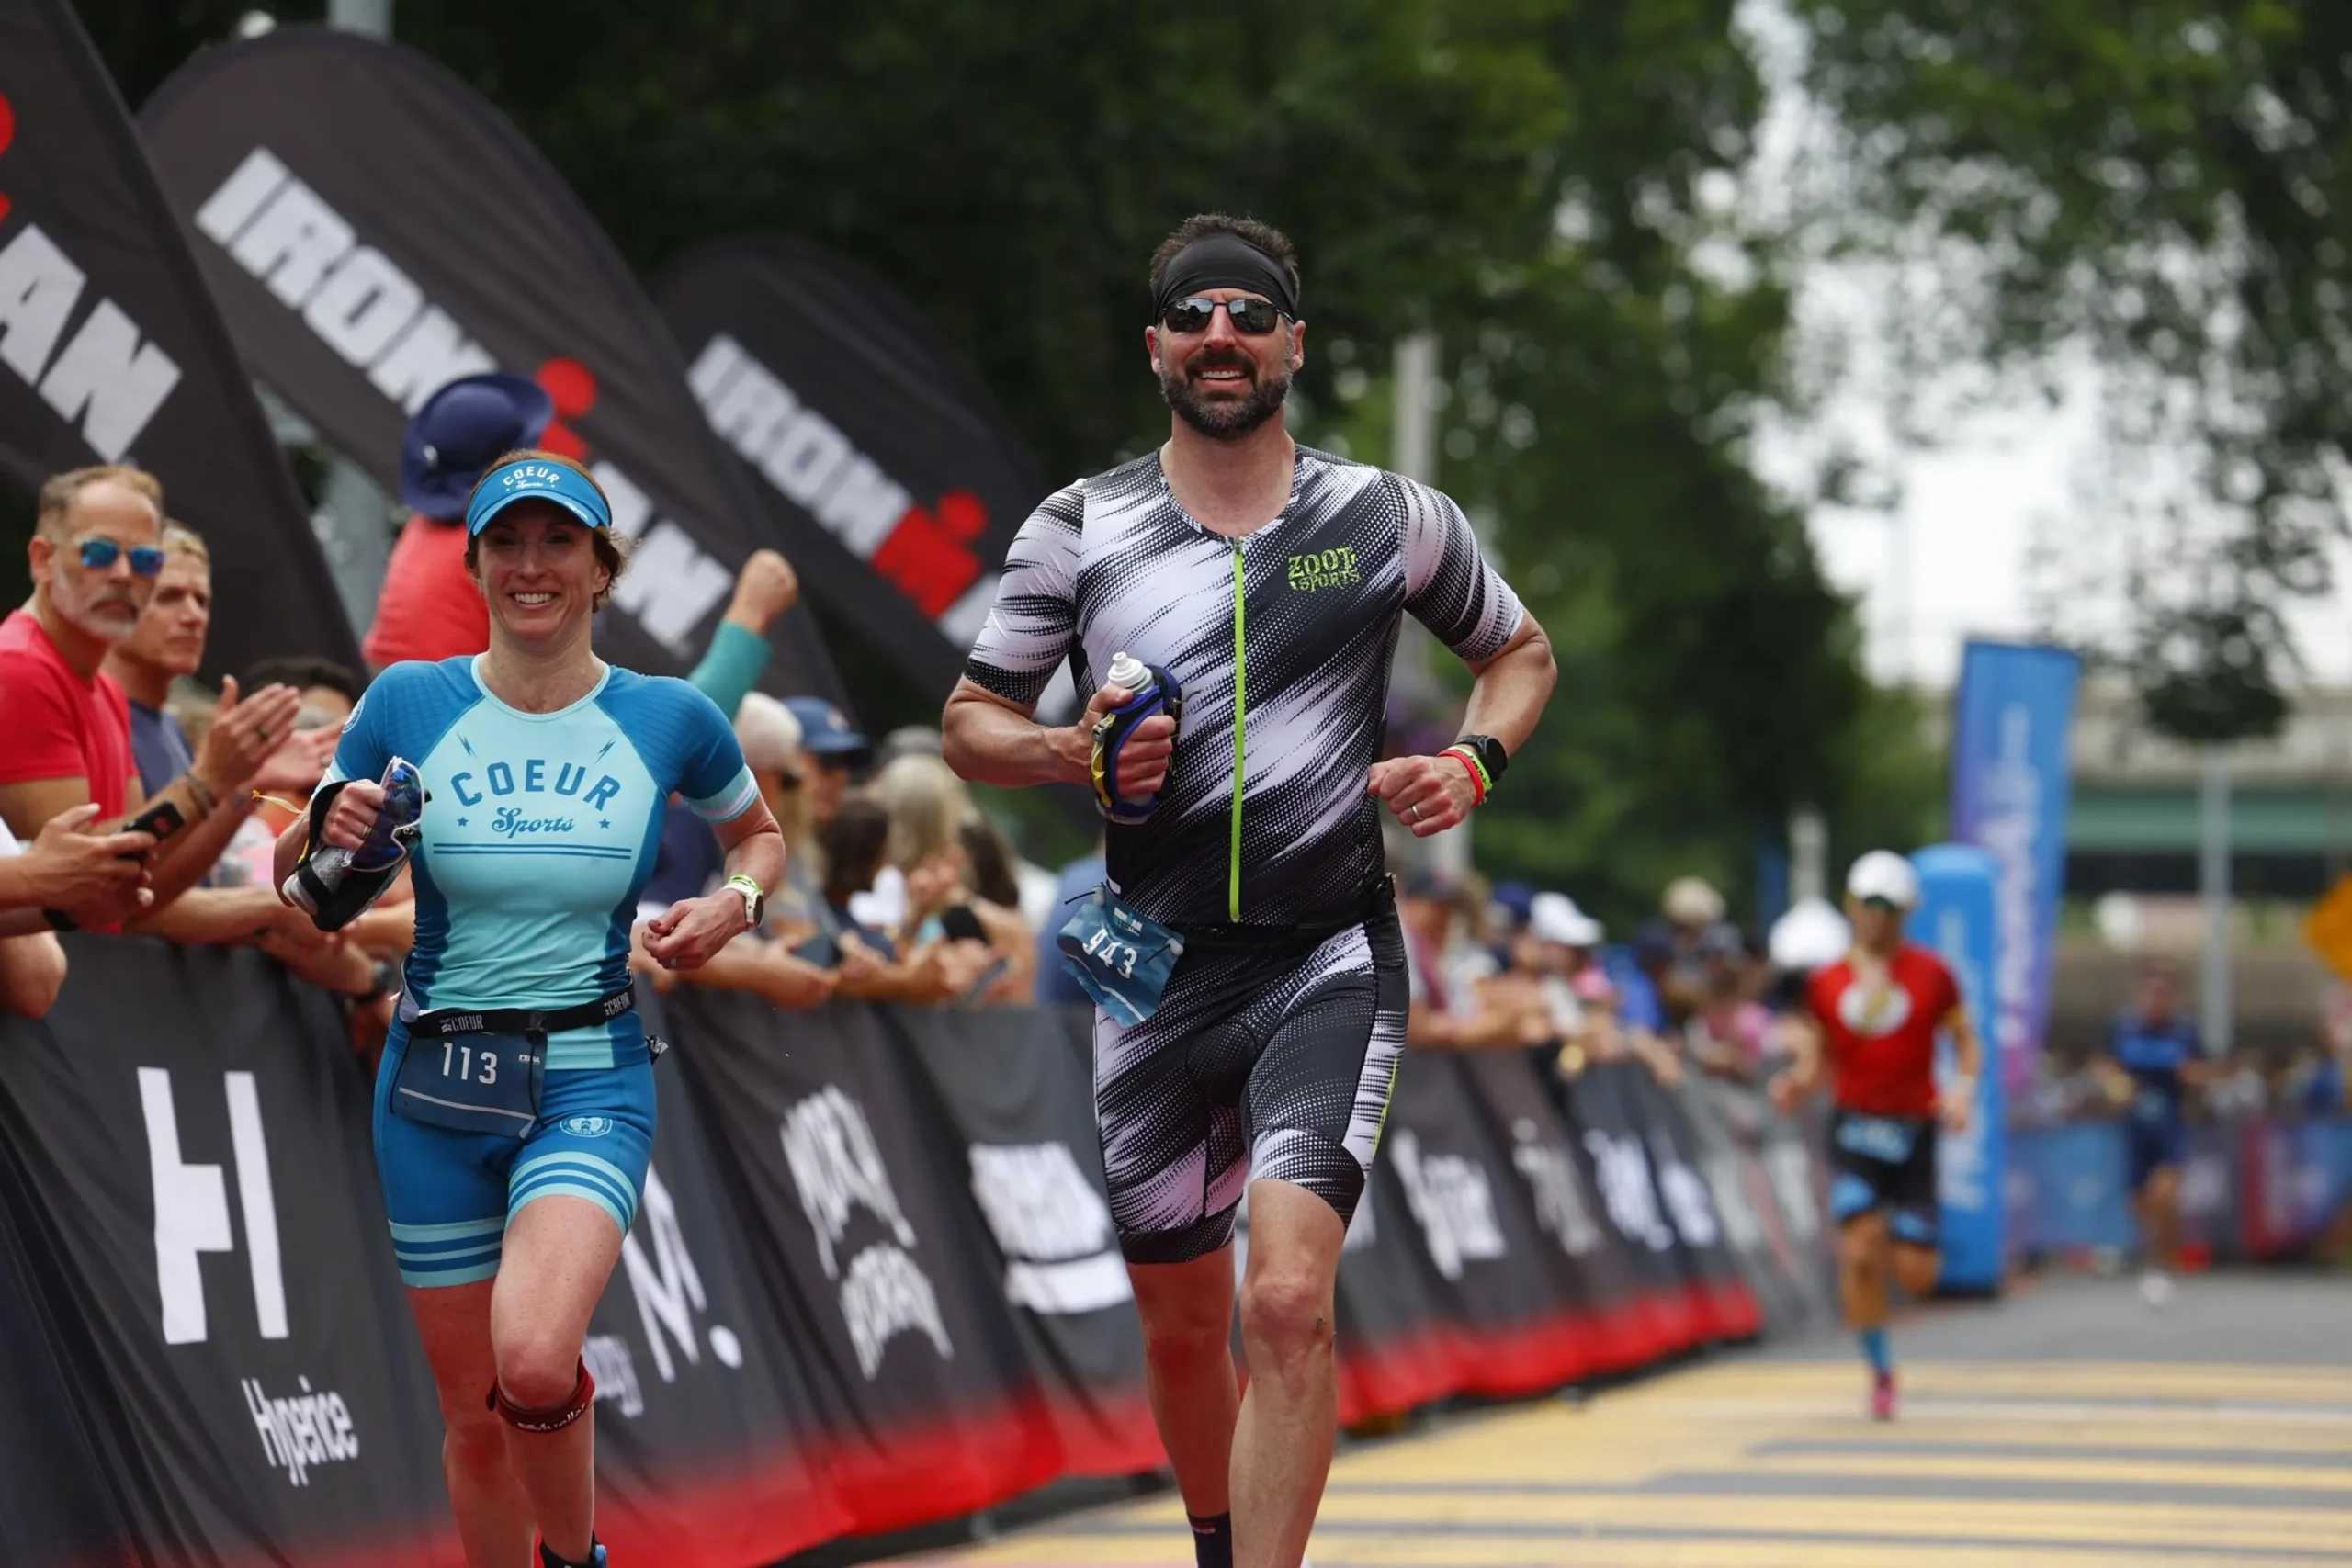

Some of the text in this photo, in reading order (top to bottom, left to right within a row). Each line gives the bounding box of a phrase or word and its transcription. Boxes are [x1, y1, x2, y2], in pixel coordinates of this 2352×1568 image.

[503, 466, 560, 486] COEUR
[1288, 547, 1352, 580] ZOOT
[1298, 567, 1360, 592] SPORTS
[450, 759, 621, 812] COEUR
[492, 807, 576, 839] Sports
[1082, 928, 1137, 979] 943
[451, 1014, 484, 1032] COEUR
[442, 1042, 497, 1085] 113
[241, 1374, 359, 1487] Hyperice
